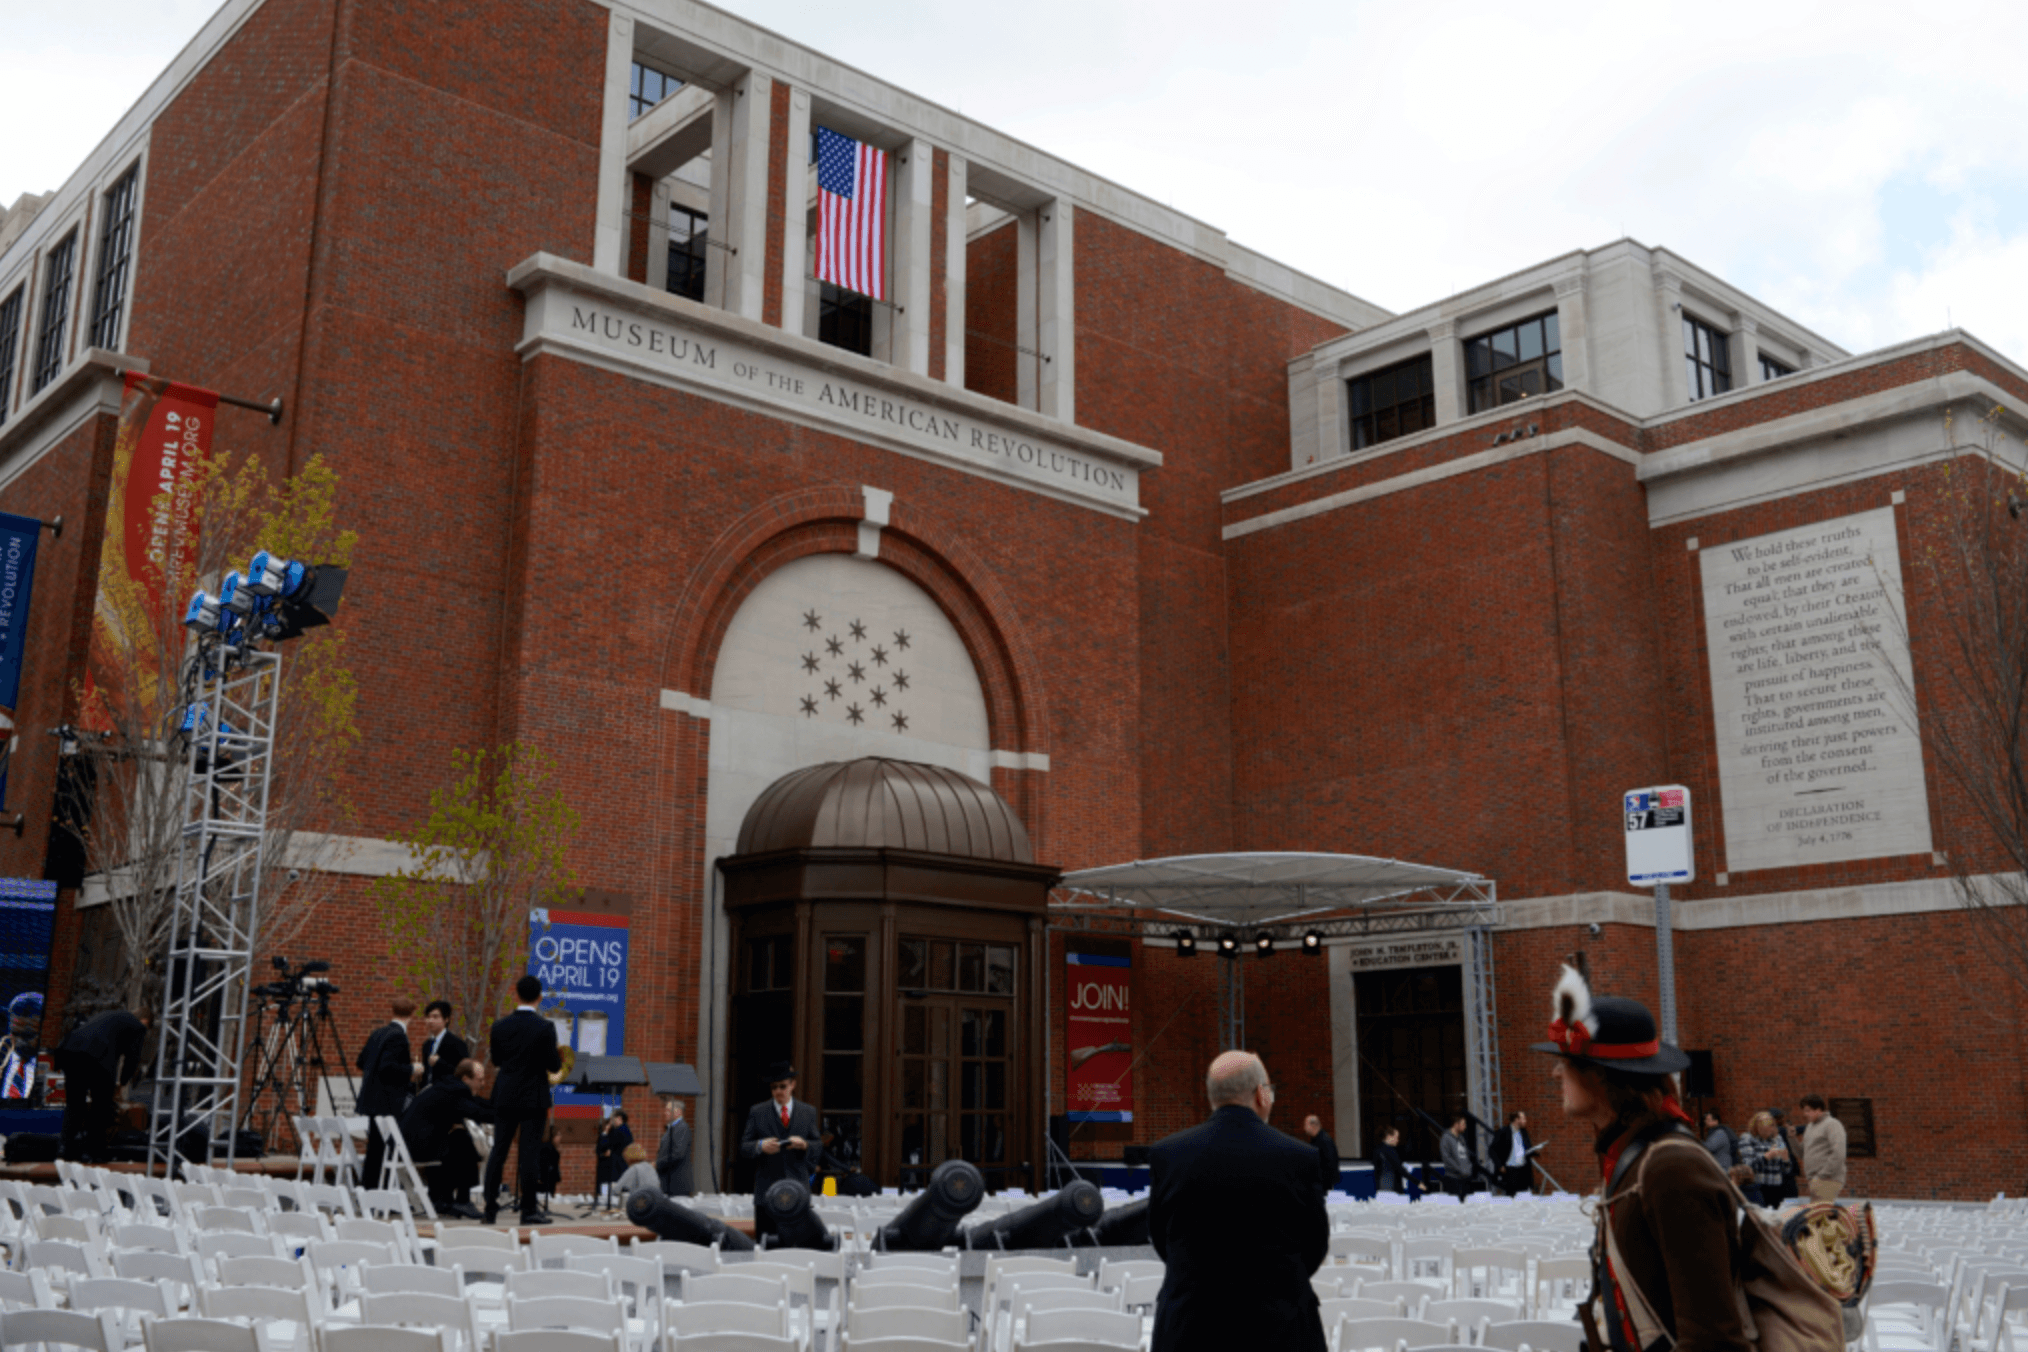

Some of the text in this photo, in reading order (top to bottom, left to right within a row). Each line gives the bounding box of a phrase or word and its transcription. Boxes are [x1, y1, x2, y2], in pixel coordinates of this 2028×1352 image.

[571, 307, 1125, 491] MUSEUM OF THE AMERICAN REVOLUTION
[165, 411, 182, 431] 19
[158, 440, 179, 494] APRIL
[1731, 526, 1861, 562] We hold these truths
[0, 536, 22, 627] REVOLUTION
[1724, 581, 1752, 595] That
[1755, 574, 1771, 589] all
[1774, 572, 1801, 584] men
[1804, 567, 1822, 578] are
[1747, 566, 1760, 575] to
[1762, 561, 1777, 572] be
[1782, 584, 1807, 598] that
[1811, 580, 1837, 594] they
[1841, 576, 1860, 587] are
[1783, 603, 1799, 618] by
[1801, 598, 1831, 613] their
[1835, 588, 1884, 606] Creator
[1728, 603, 1878, 642] with certain unalienable
[1771, 639, 1796, 651] that
[1801, 631, 1845, 647] among
[1847, 623, 1881, 638] these
[1737, 662, 1754, 674] are
[1832, 641, 1856, 656] and
[1743, 677, 1874, 707] That to secure these
[1745, 673, 1789, 695] pursuit
[1791, 666, 1807, 681] of
[1783, 696, 1864, 719] governments
[1866, 691, 1887, 703] are
[1745, 716, 1804, 737] instituted
[1807, 713, 1850, 728] among
[1740, 725, 1897, 756] deriving their just powers
[1761, 744, 1873, 769] from the consent
[1766, 770, 1781, 784] of
[1783, 767, 1804, 783] the
[1628, 811, 1647, 830] 57
[1766, 811, 1882, 833] OF INDEPENDENCE
[1779, 800, 1865, 819] DECLARATION
[1797, 834, 1816, 848] July
[535, 936, 622, 967] OPENS
[536, 963, 620, 989] APRIL 19
[1070, 982, 1129, 1011] JOIN!
